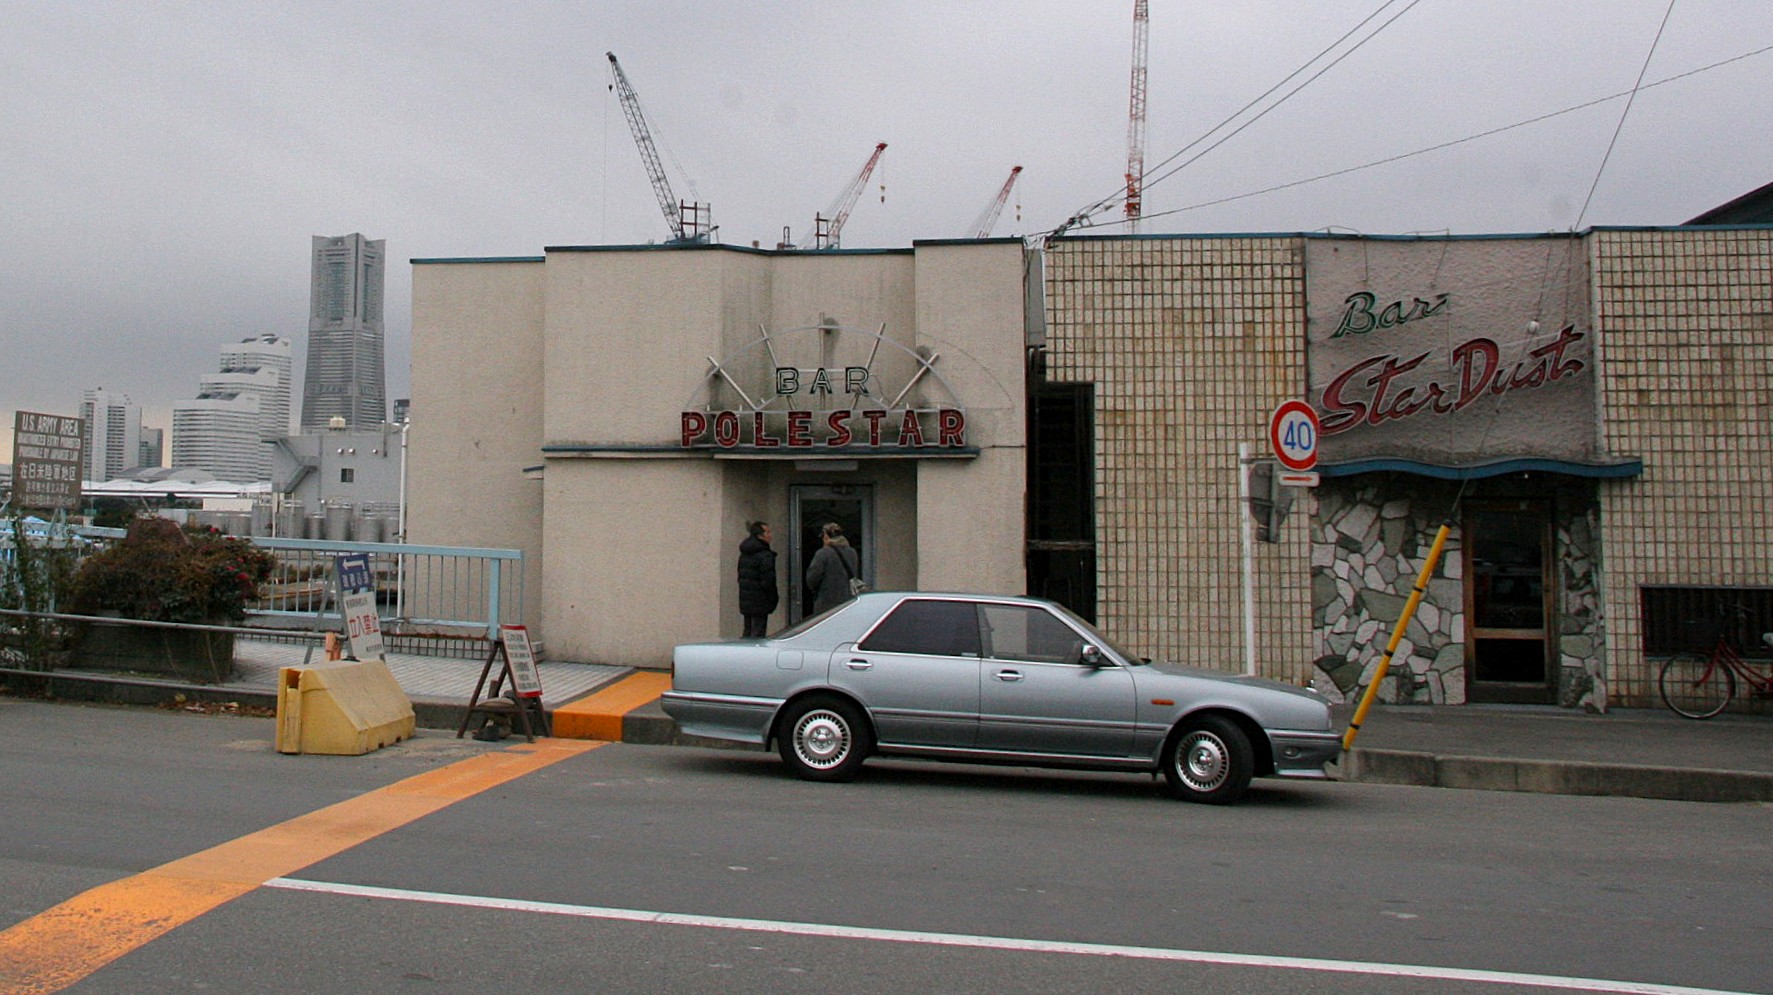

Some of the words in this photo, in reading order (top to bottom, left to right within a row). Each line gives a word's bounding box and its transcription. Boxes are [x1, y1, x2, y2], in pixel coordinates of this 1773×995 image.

[1329, 290, 1450, 339] Bar
[775, 366, 870, 395] BAR
[22, 413, 36, 431] U.S.
[37, 416, 58, 434] ARMY
[60, 419, 79, 436] AREA
[680, 408, 967, 448] POLESTAR
[1283, 420, 1313, 451] 40
